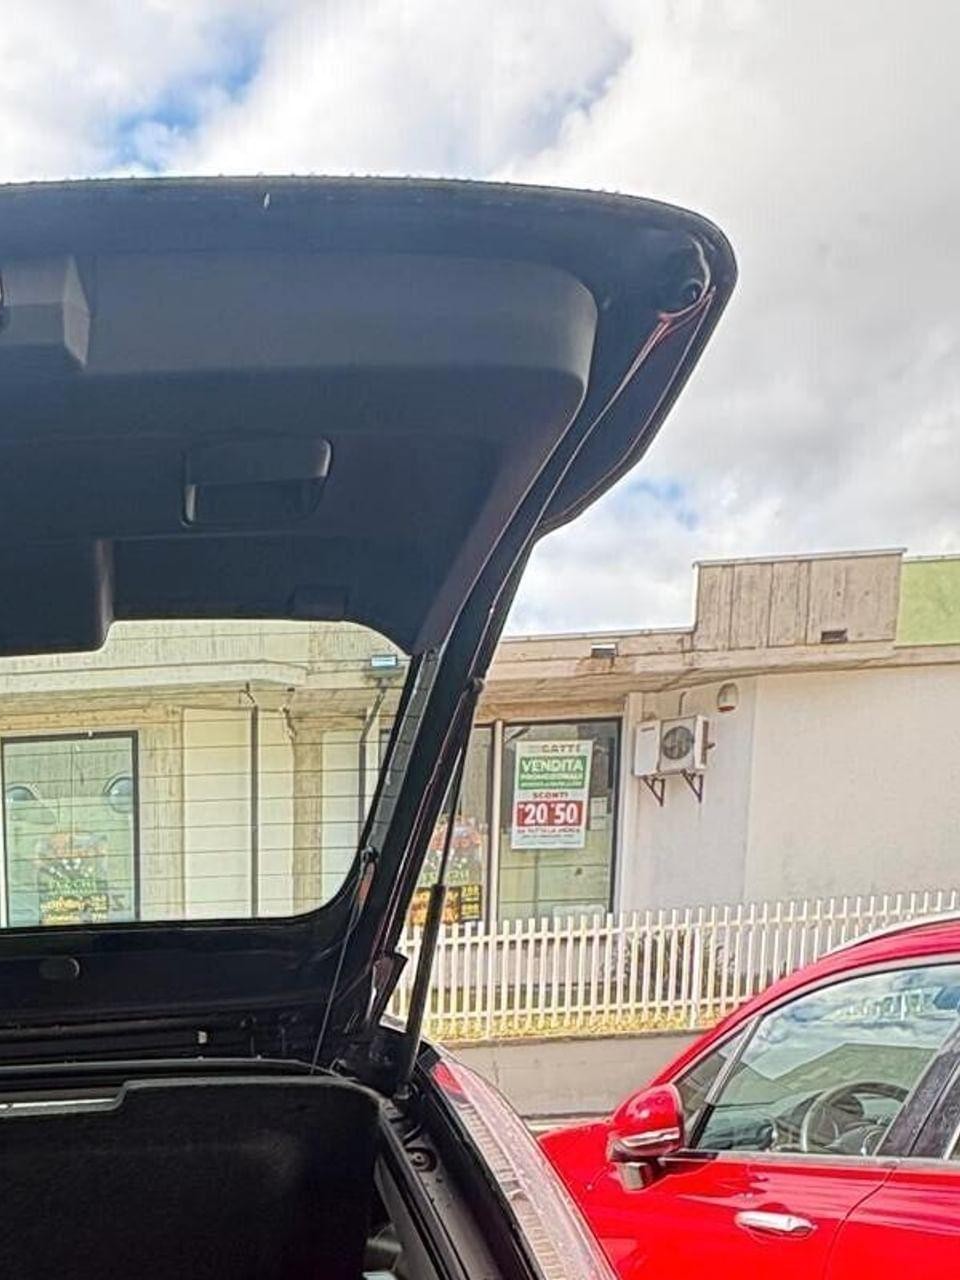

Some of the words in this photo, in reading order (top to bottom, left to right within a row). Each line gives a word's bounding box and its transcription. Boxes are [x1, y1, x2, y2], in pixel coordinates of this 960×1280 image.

[521, 758, 584, 773] VENDITA
[524, 802, 548, 825] 20
[554, 802, 578, 825] 50
